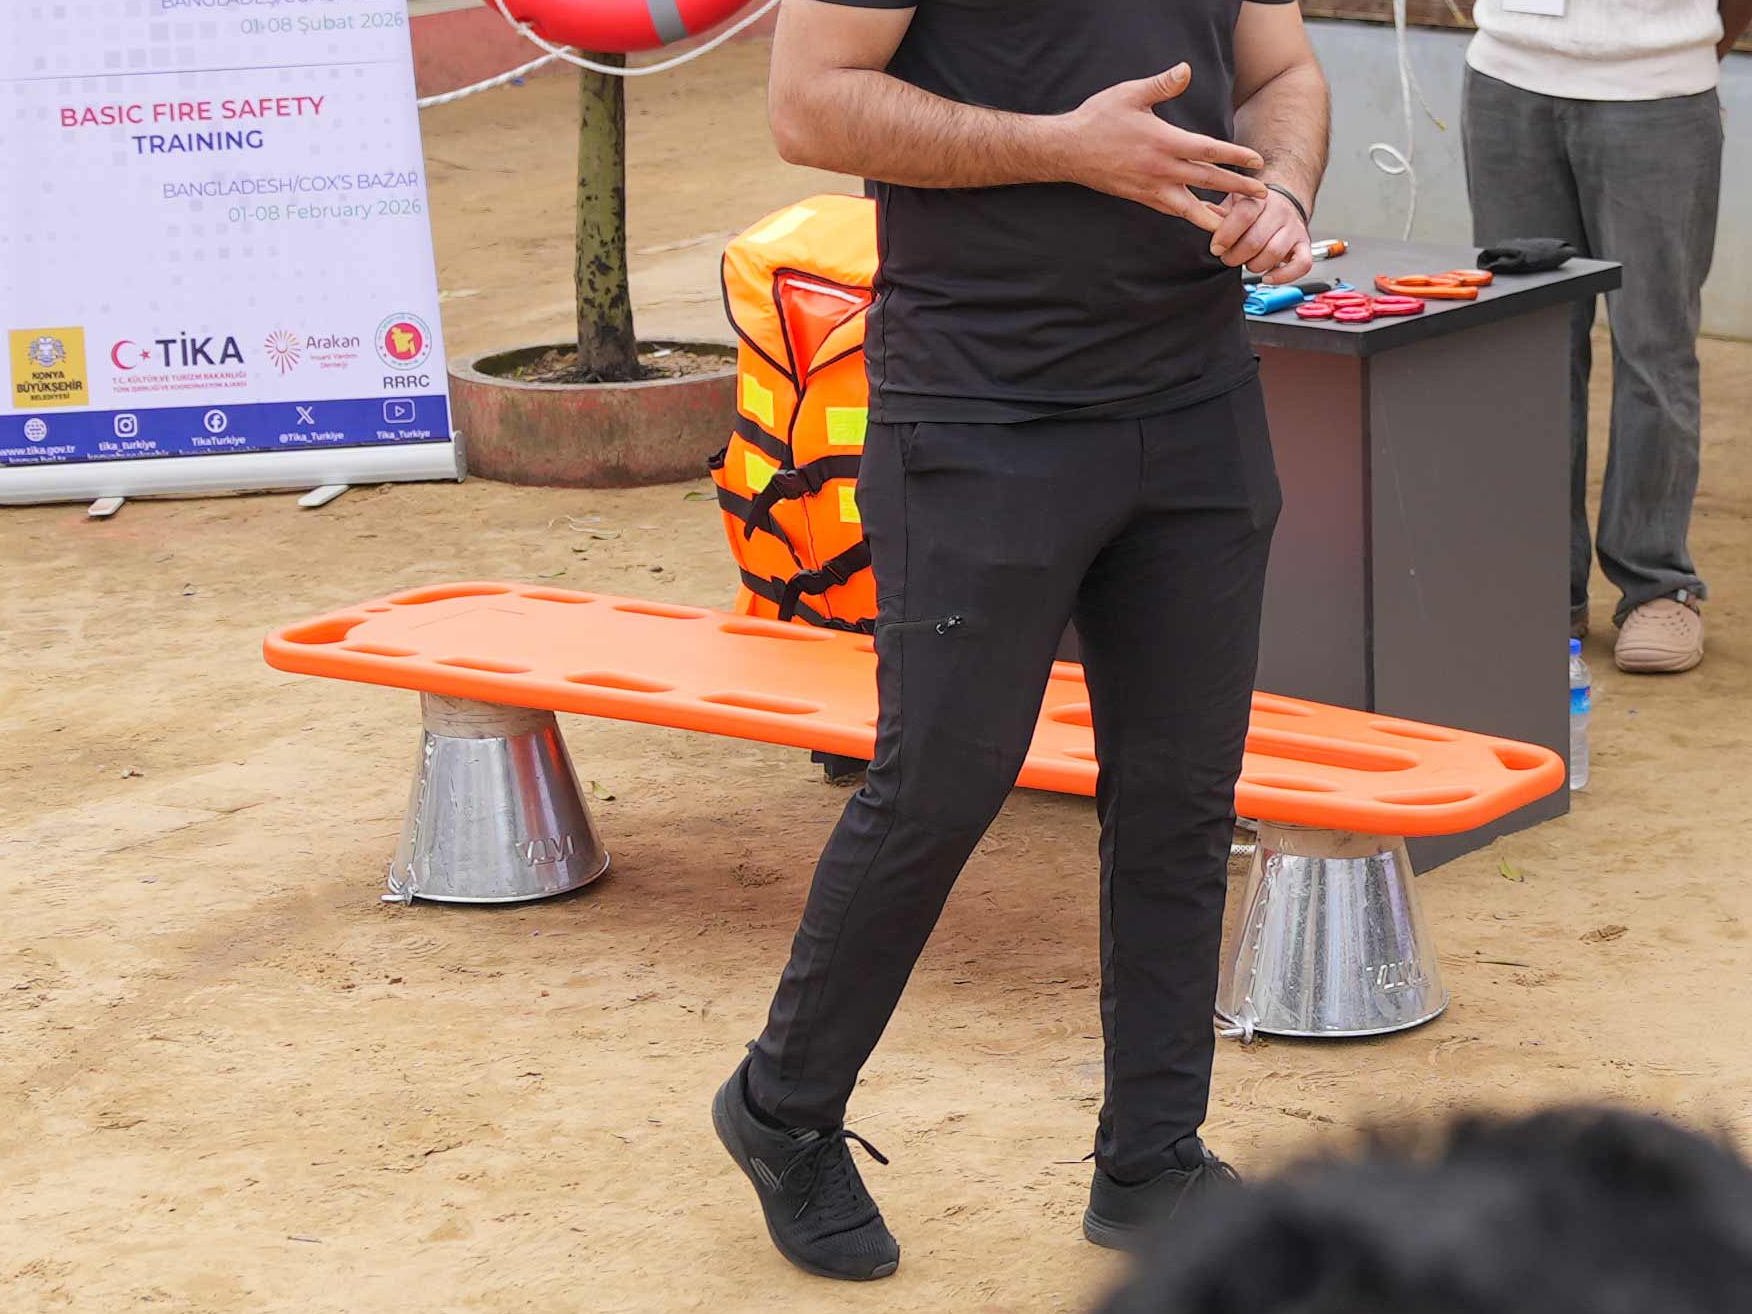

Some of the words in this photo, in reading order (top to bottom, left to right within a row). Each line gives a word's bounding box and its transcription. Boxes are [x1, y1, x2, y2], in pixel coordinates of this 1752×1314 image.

[297, 14, 355, 35] Şubat
[360, 12, 404, 30] 2026
[60, 104, 143, 127] BASIC
[153, 101, 212, 122] FIRE
[221, 96, 325, 119] SAFETY
[132, 130, 264, 154] TRAINING
[163, 175, 352, 199] BANGLADESH/COX'S
[357, 172, 418, 191] BAZAR
[228, 205, 280, 223] 01-08
[286, 201, 372, 222] February
[378, 198, 422, 216] 2026
[155, 331, 245, 368] TİKA
[306, 334, 360, 350] Arakan
[383, 375, 430, 390] RRRC
